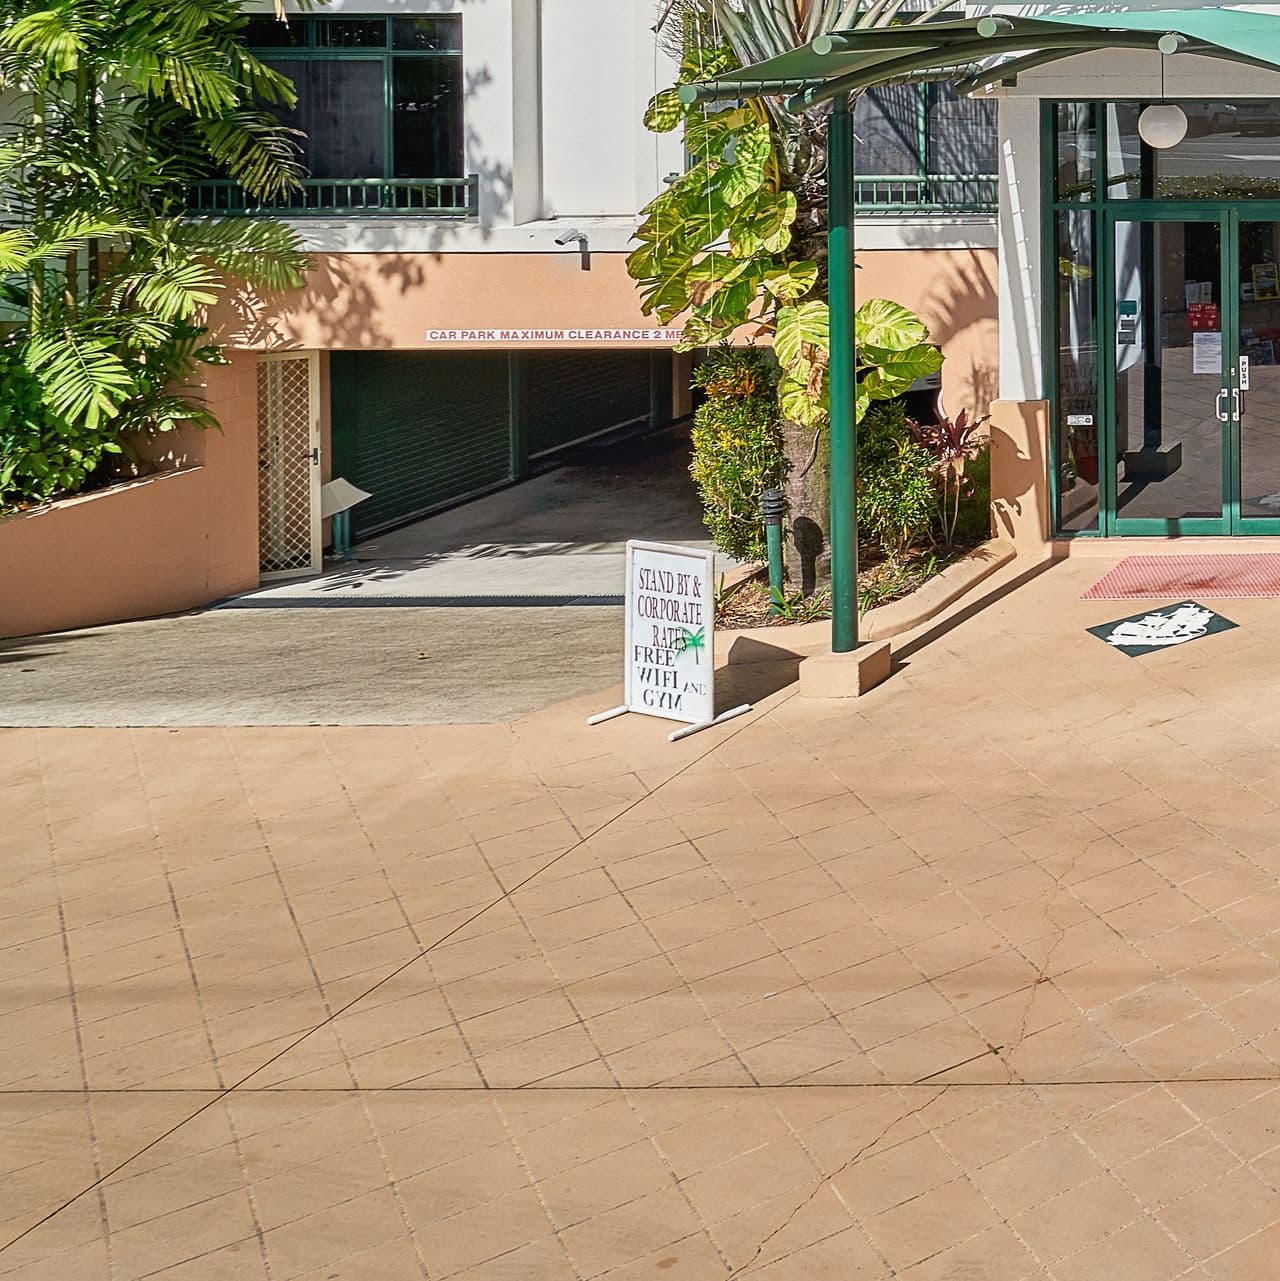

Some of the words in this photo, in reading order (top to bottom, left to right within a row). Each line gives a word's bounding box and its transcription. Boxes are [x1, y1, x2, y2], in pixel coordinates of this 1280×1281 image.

[429, 330, 457, 340] CAR
[460, 330, 496, 340] PARK
[500, 330, 565, 340] MAXIMUM
[568, 330, 650, 340] CLEARANCE
[653, 330, 662, 339] 2
[639, 567, 674, 595] STAND
[677, 572, 691, 597] BY
[693, 575, 702, 598] &
[637, 594, 703, 626] CORPORATE
[652, 624, 687, 652] RATES
[634, 645, 675, 668] FREE
[637, 666, 679, 689] WIFI
[683, 681, 706, 696] AND
[643, 688, 682, 711] GYM
